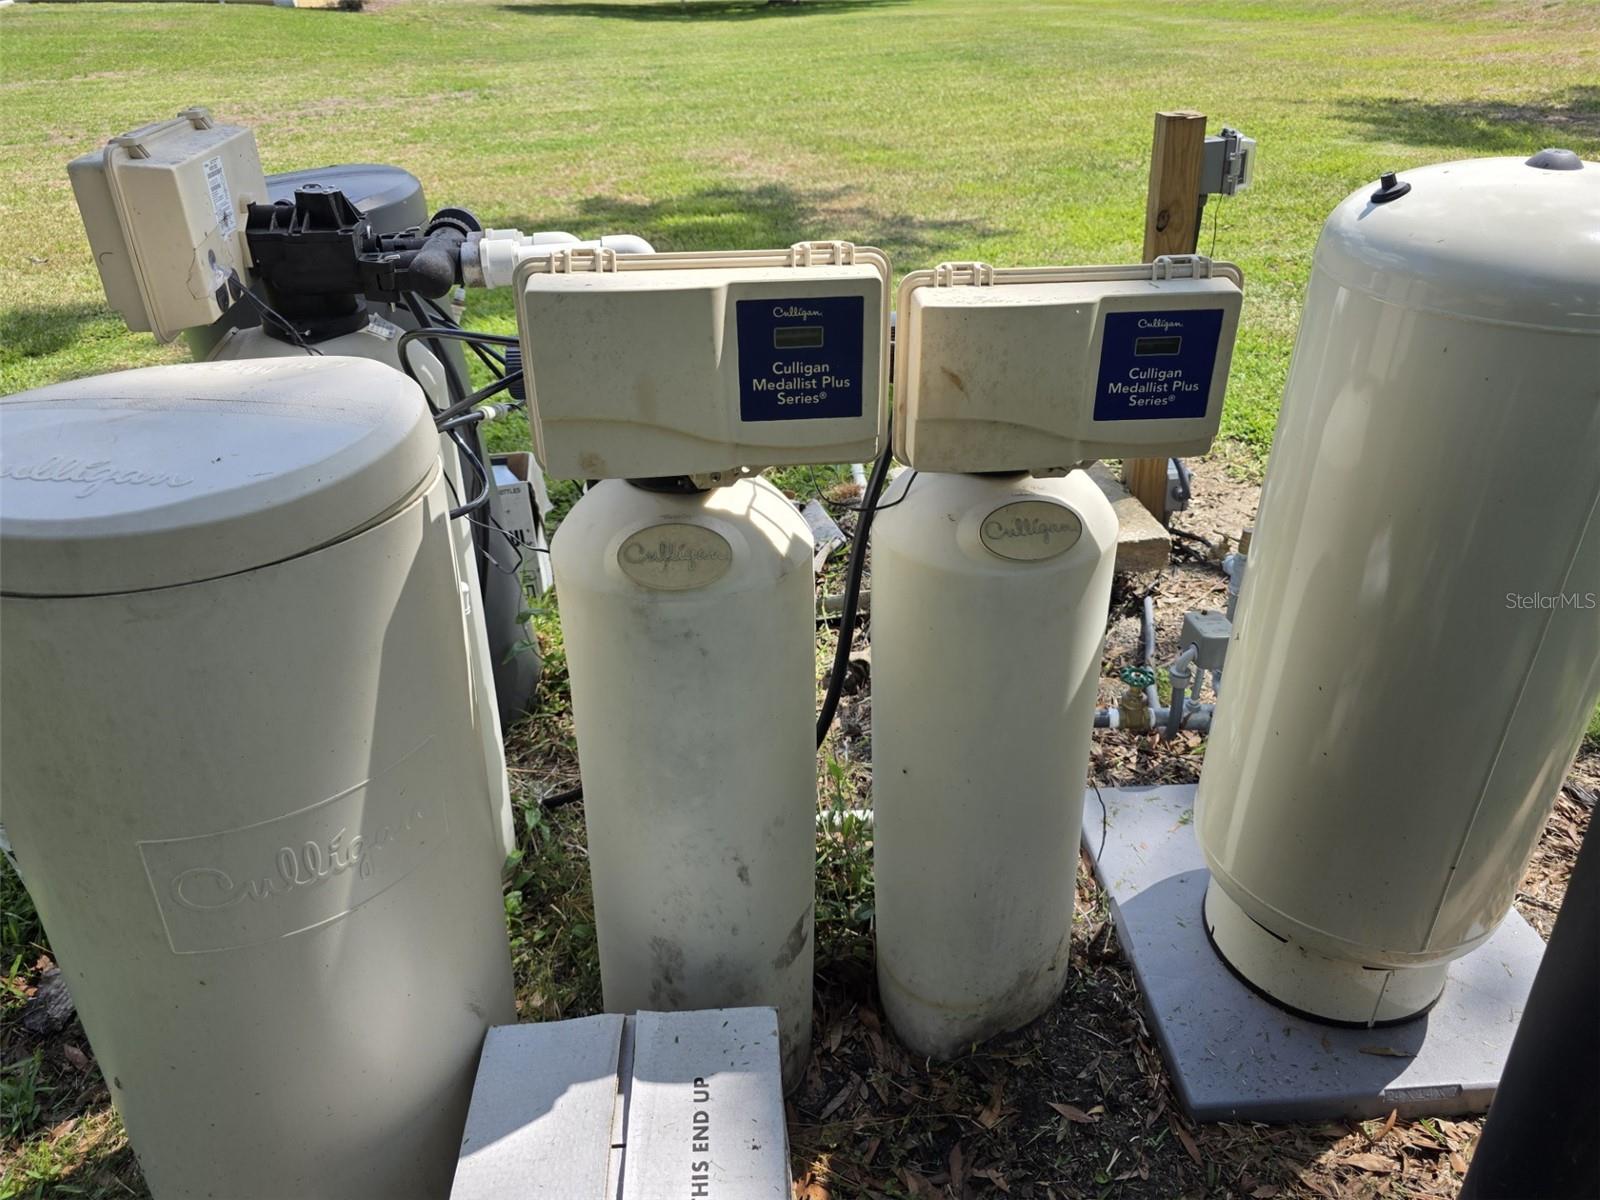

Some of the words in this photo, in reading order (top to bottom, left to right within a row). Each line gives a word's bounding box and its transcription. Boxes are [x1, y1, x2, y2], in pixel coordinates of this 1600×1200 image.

[772, 306, 823, 321] Culligan
[1137, 318, 1184, 332] Culligan
[772, 361, 830, 377] Culligan
[1128, 367, 1183, 381] Culligan
[752, 378, 817, 391] Medallist
[822, 375, 851, 388] Plus
[1107, 382, 1169, 394] Medallist
[1172, 380, 1200, 392] Plus
[0, 456, 194, 500] ulligan
[985, 517, 1079, 545] Culligan
[623, 541, 729, 572] Culligan
[693, 1077, 709, 1103] UP
[692, 1110, 709, 1153] END
[691, 1160, 709, 1200] HIS
